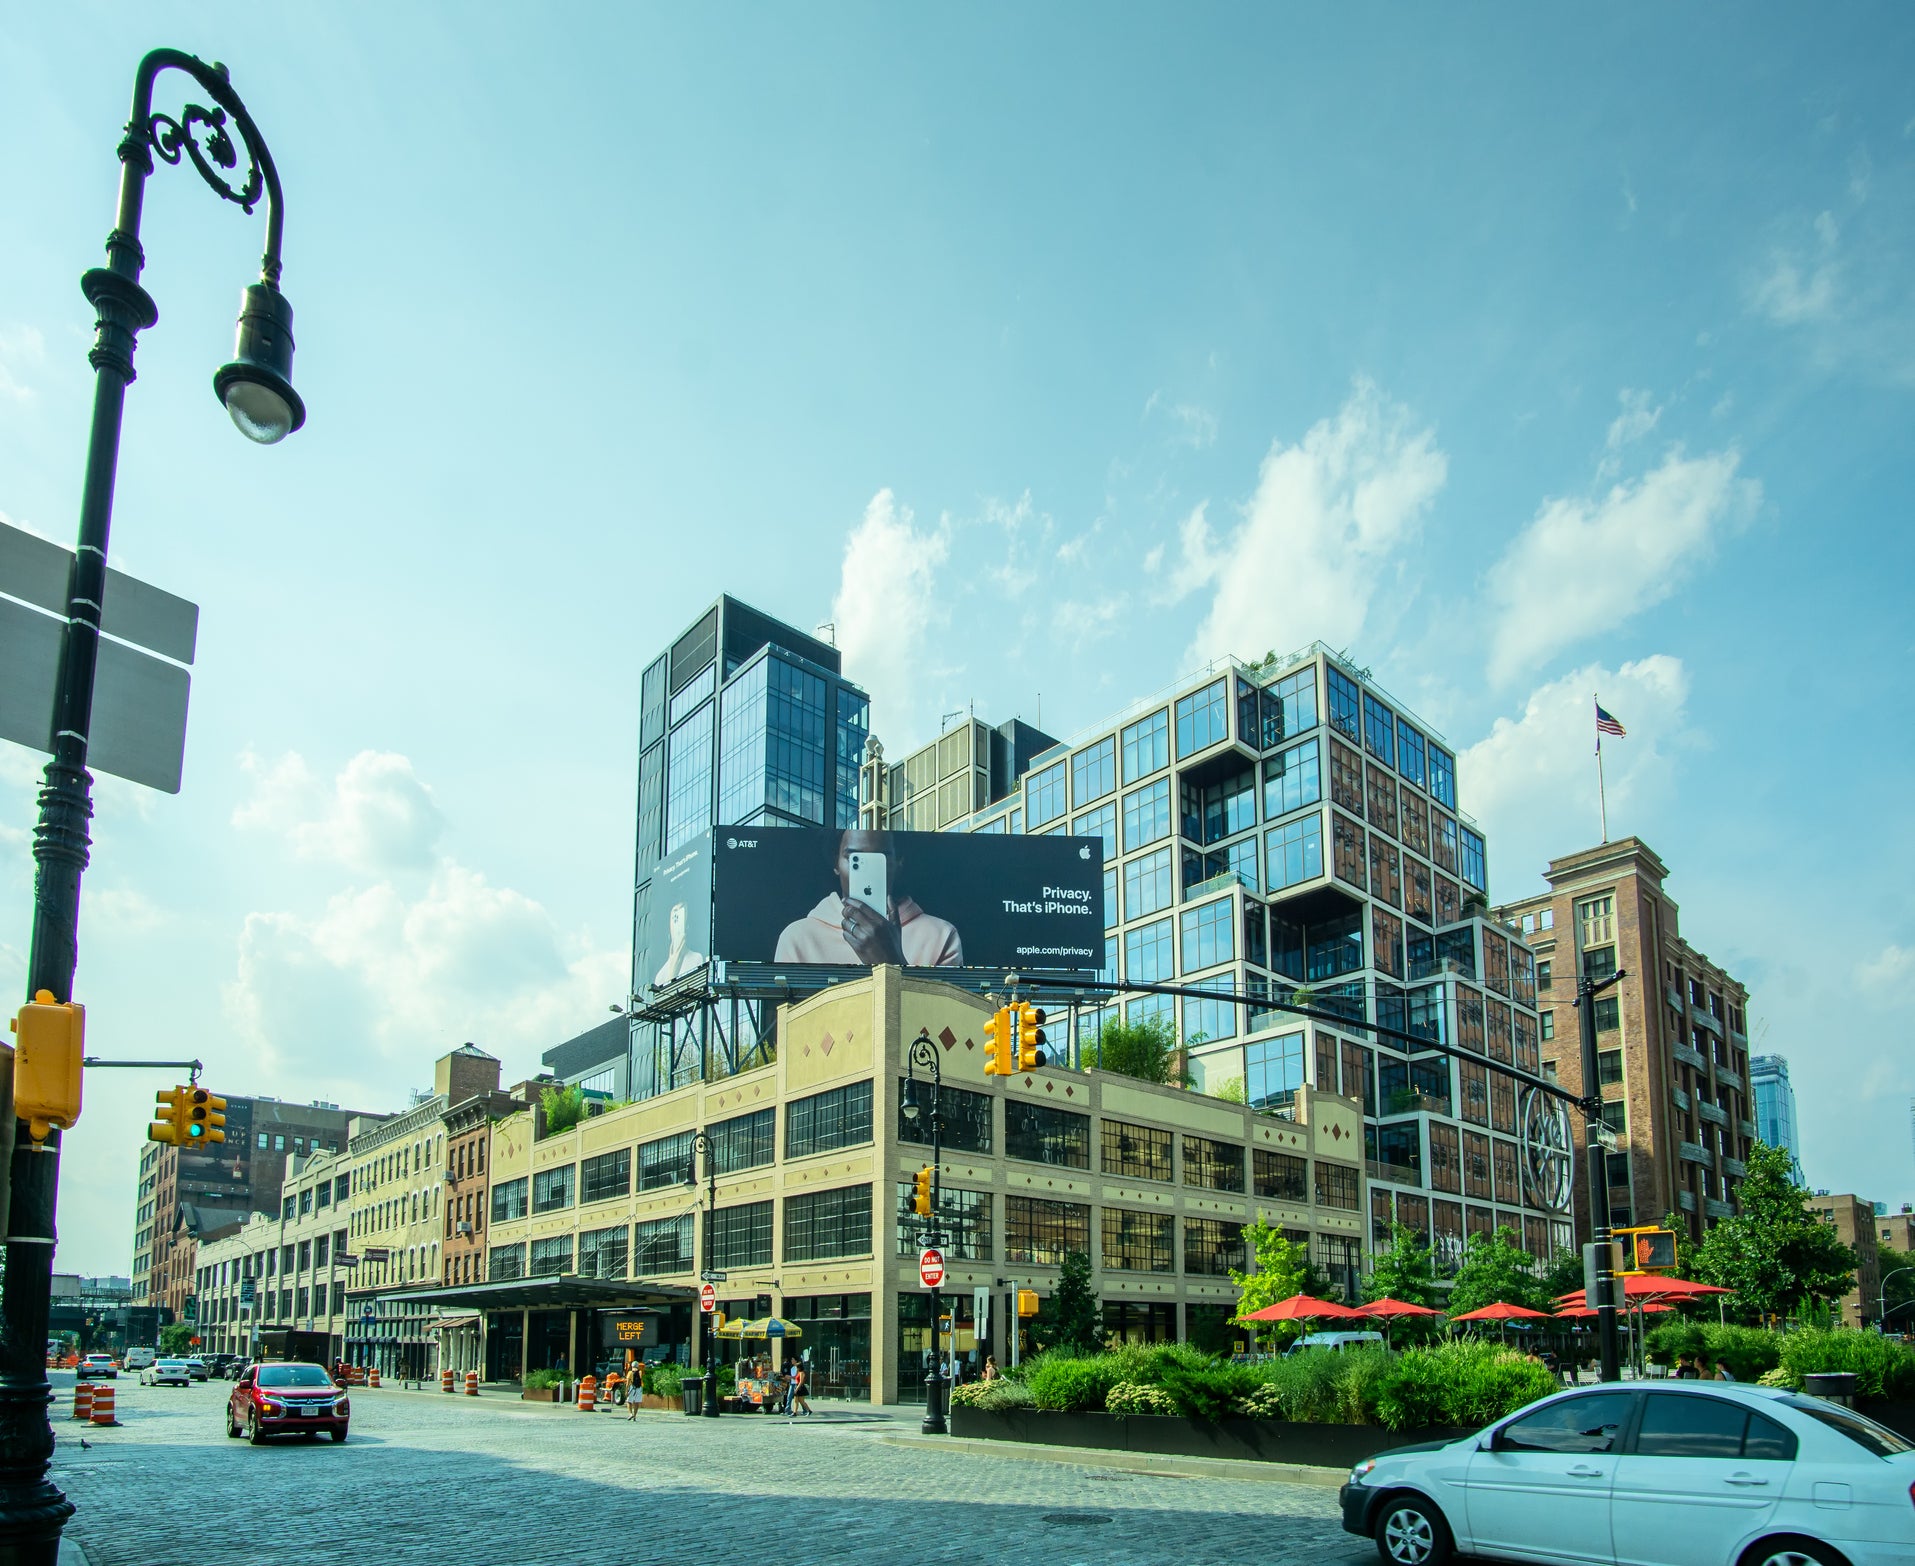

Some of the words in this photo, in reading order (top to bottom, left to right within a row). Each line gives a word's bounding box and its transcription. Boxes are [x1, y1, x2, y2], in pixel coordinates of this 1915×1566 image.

[738, 840, 758, 848] AT&T
[1042, 886, 1092, 902] Privacy.
[1002, 900, 1043, 913] That's
[1045, 902, 1093, 915] iPhone.
[1016, 946, 1094, 958] apple.com/privacy
[924, 1256, 931, 1264] DO
[931, 1255, 940, 1264] NOT
[925, 1272, 940, 1280] ENTER
[616, 1322, 645, 1331] MERGE
[619, 1332, 641, 1341] LEFT
